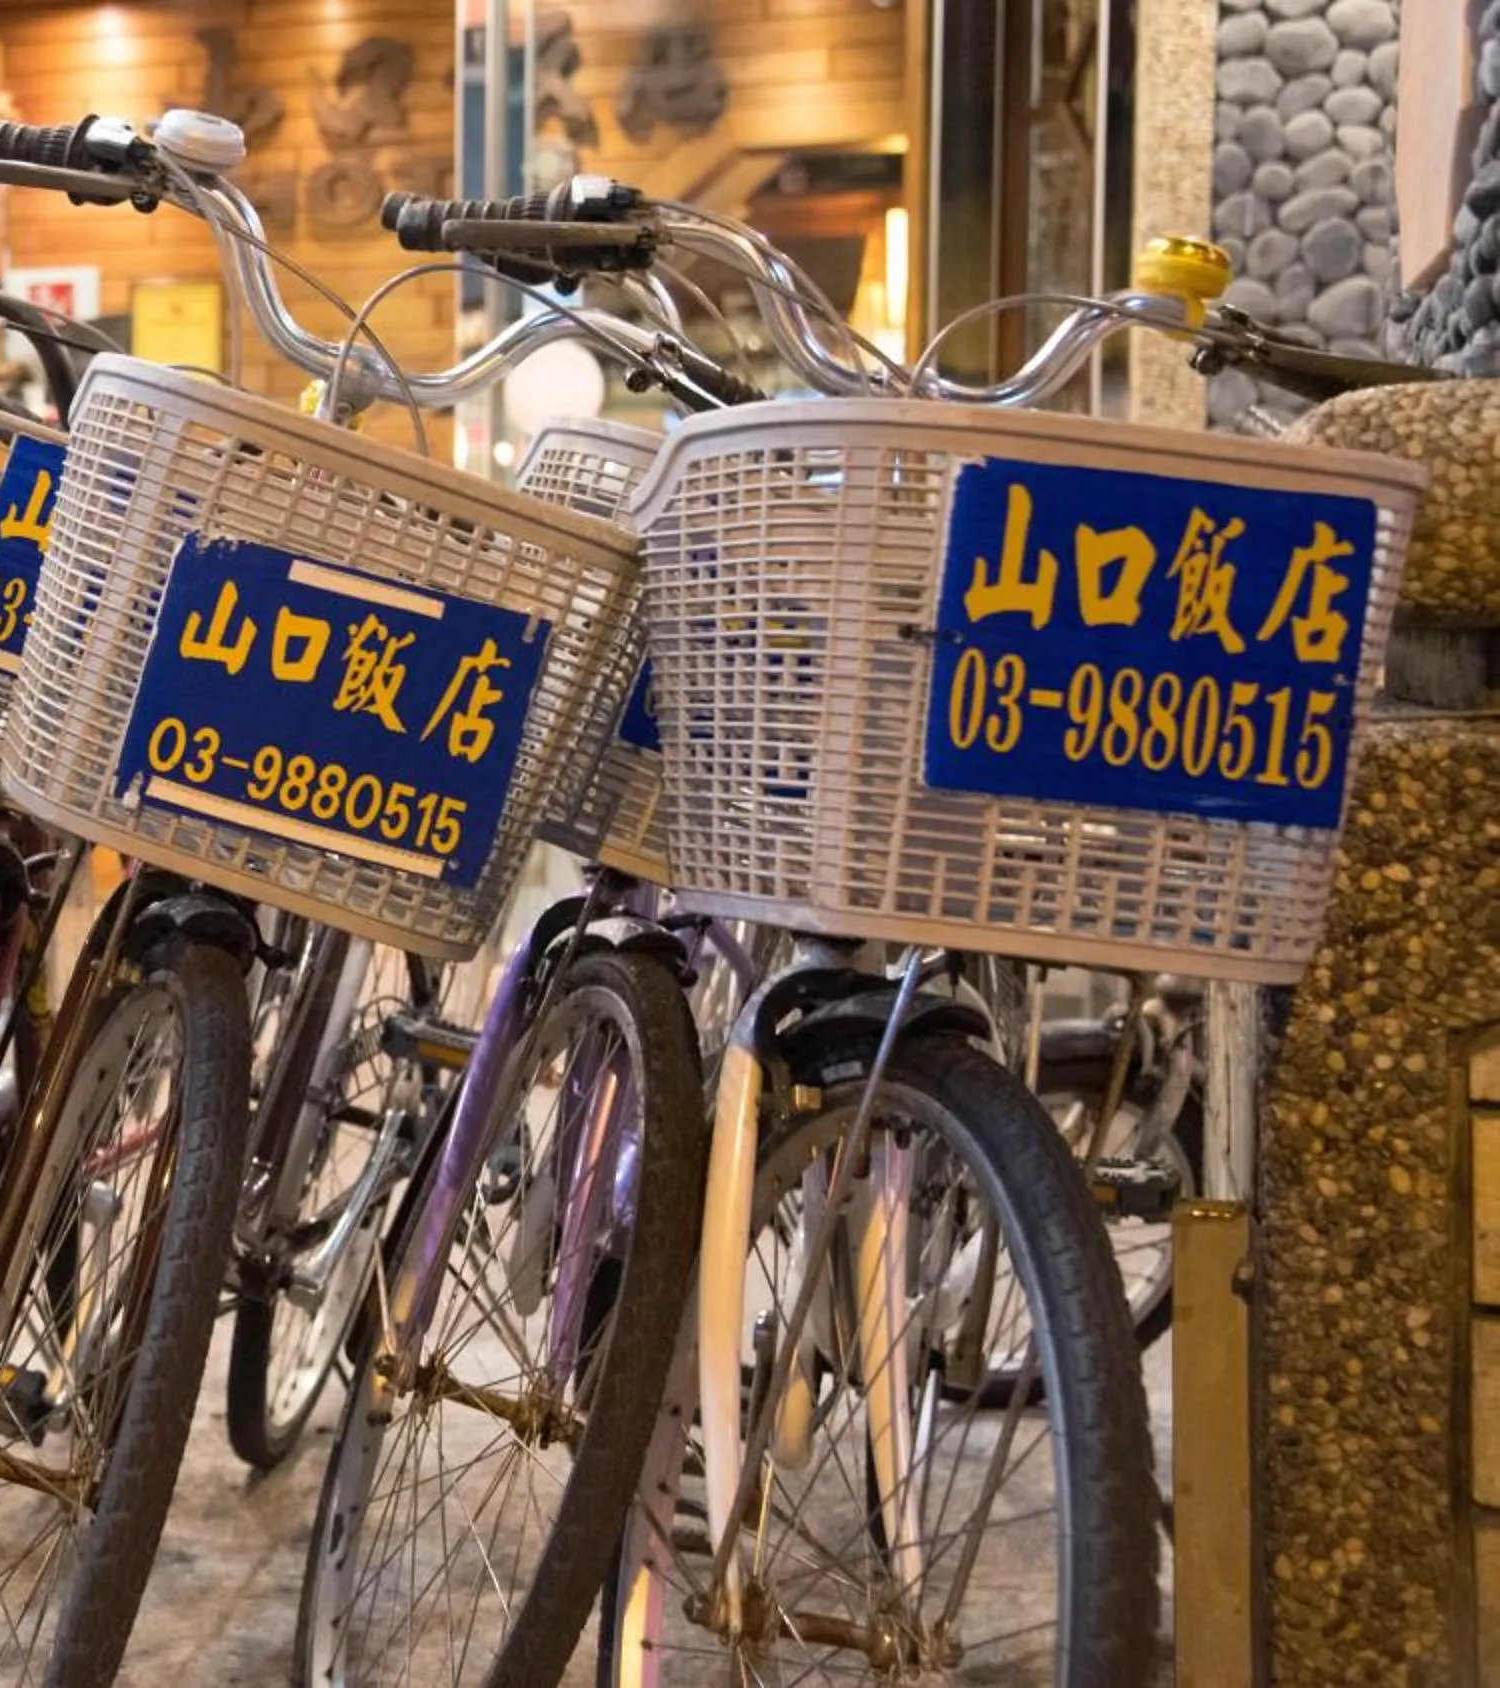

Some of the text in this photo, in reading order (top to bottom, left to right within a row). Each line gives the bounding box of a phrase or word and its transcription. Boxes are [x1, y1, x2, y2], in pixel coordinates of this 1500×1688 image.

[963, 483, 1355, 664] 山口飯店
[178, 580, 511, 765] 山口飯店
[949, 648, 1338, 789] 03-9880515
[148, 716, 466, 855] 03-9880515
